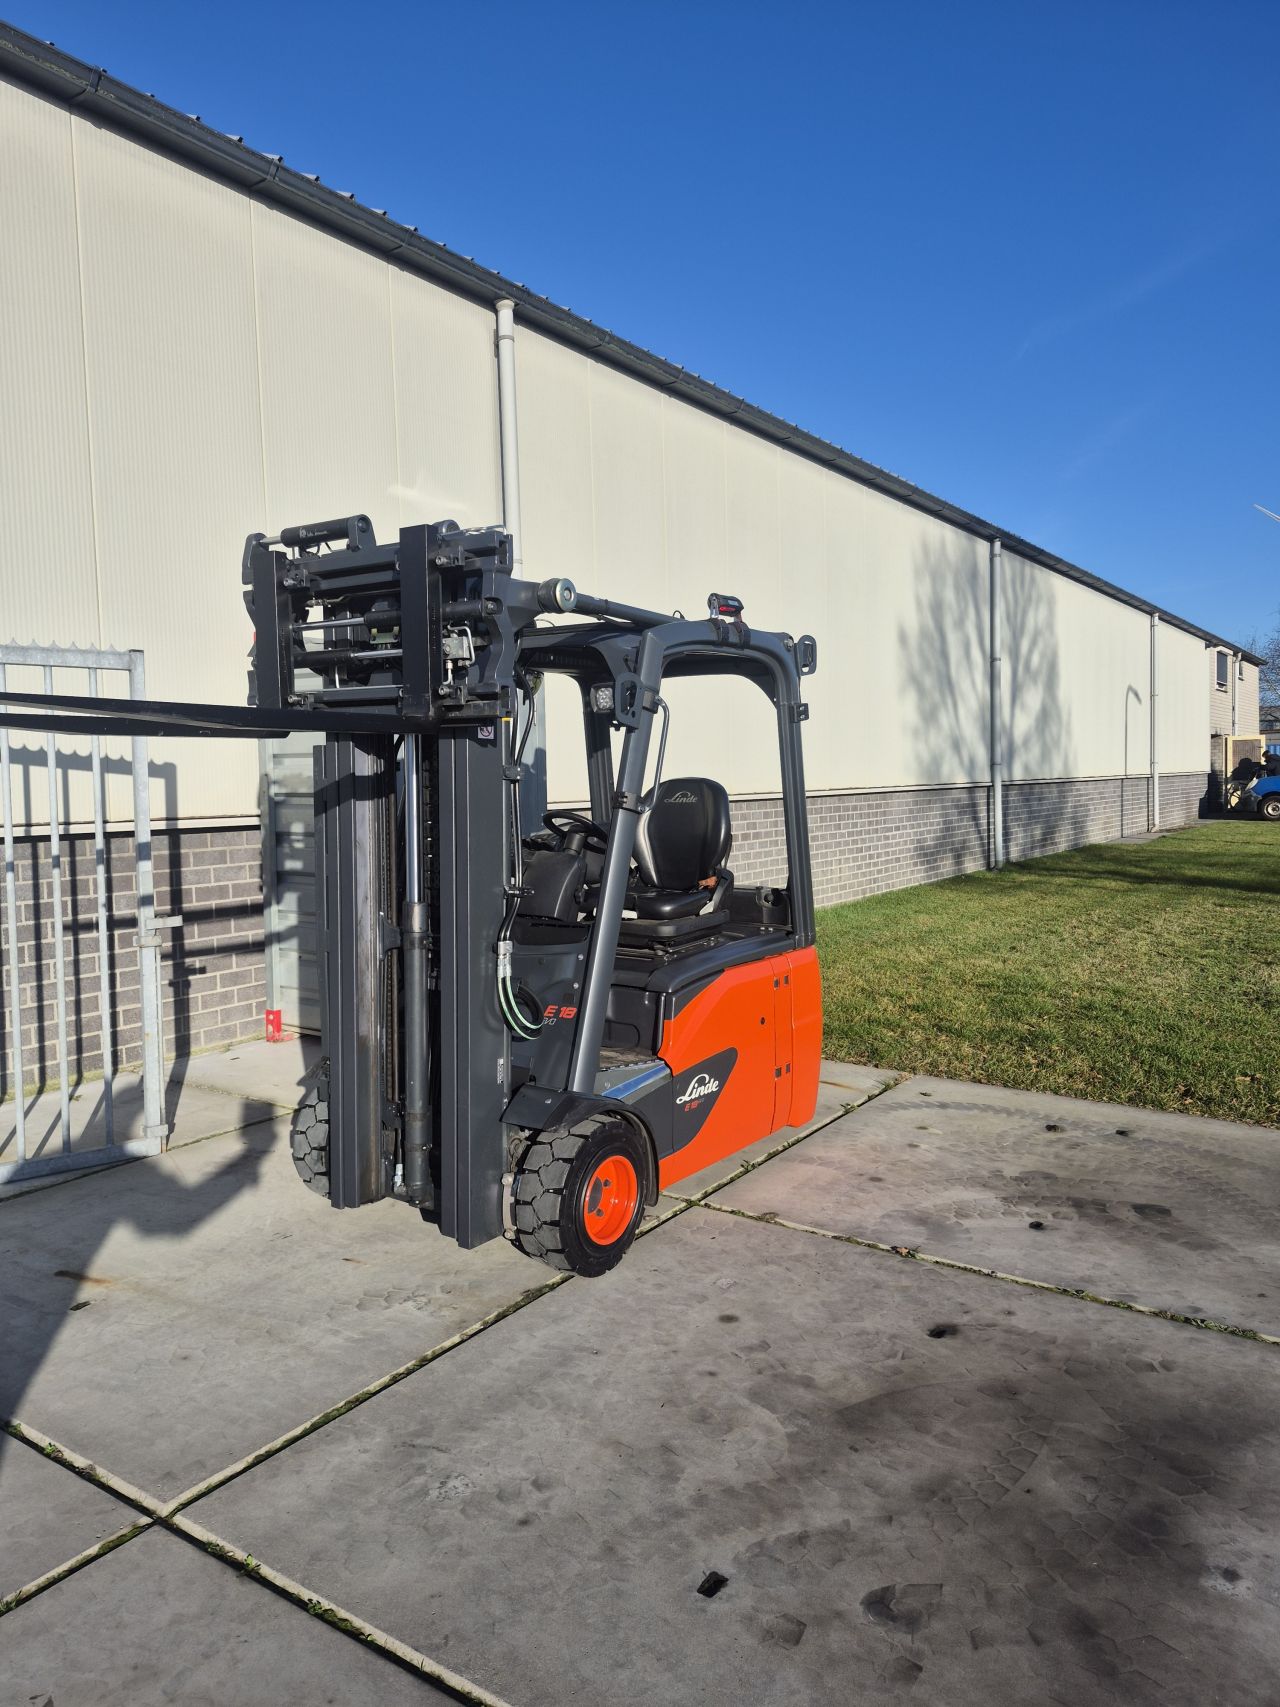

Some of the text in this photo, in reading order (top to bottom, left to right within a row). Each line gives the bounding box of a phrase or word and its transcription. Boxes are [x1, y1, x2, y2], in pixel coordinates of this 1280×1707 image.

[664, 791, 698, 803] Linde
[543, 1004, 578, 1019] E 18
[676, 1073, 719, 1104] Linde
